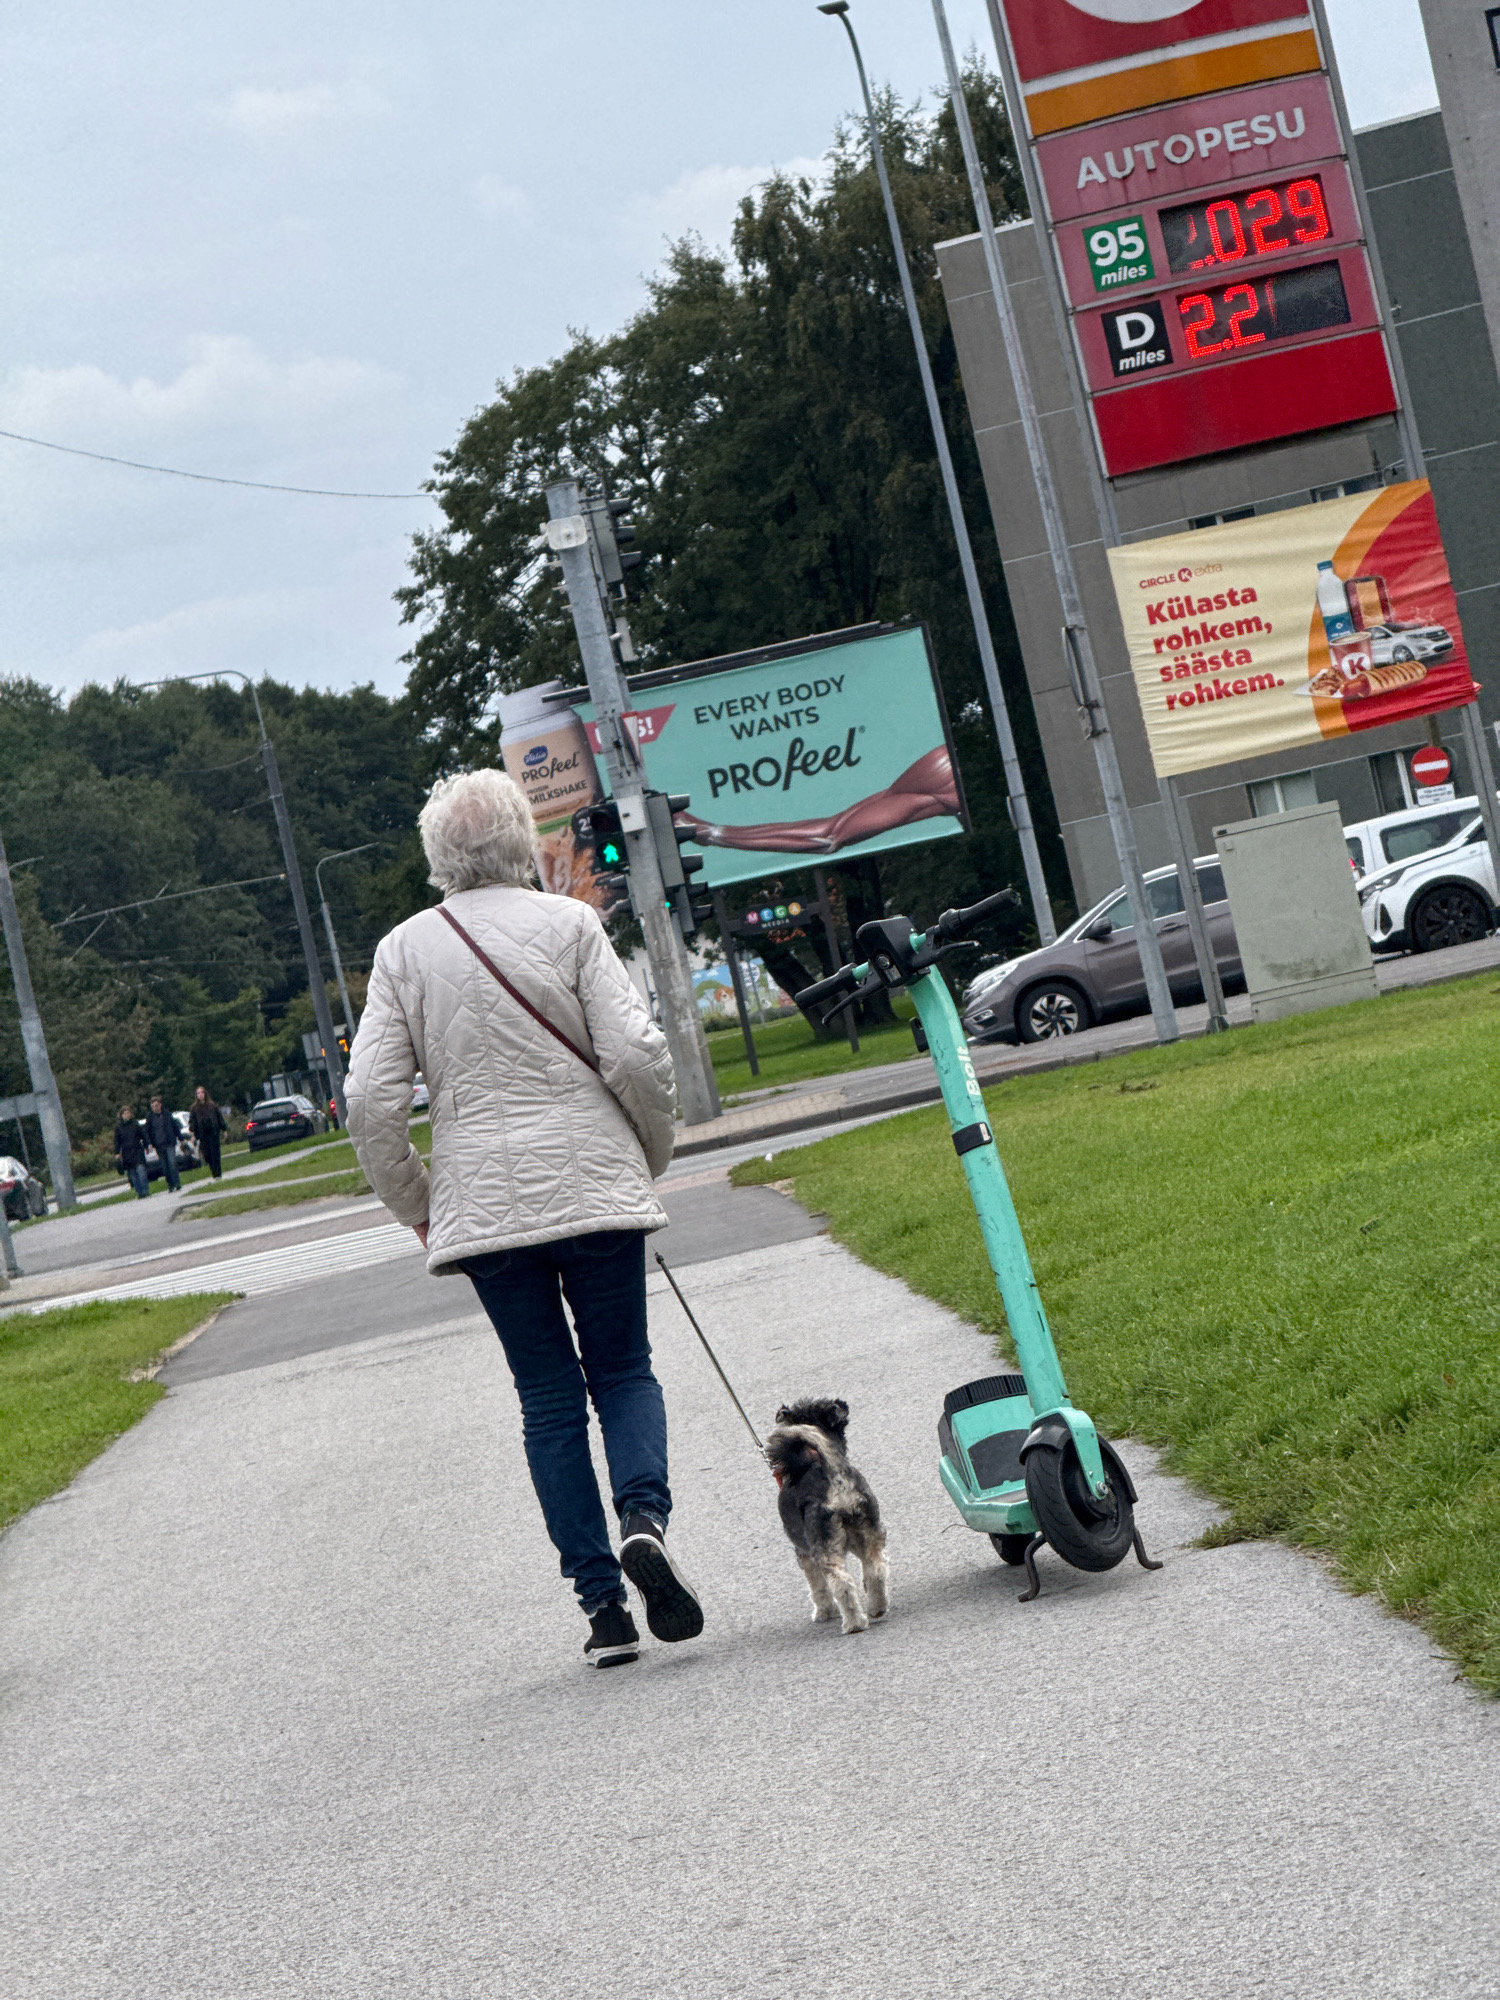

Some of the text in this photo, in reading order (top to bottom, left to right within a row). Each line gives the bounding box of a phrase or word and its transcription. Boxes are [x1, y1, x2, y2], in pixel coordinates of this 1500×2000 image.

[1076, 107, 1306, 190] AUTOPESU
[1089, 223, 1146, 267] 95
[1100, 263, 1147, 287] miles
[1116, 311, 1155, 350] D
[1118, 347, 1166, 372] miles
[1139, 563, 1223, 589] CIRCLE K extra
[1145, 587, 1258, 626] Külasta
[1153, 616, 1273, 654] rohkem,
[1159, 648, 1253, 683] säästa
[1348, 656, 1366, 676] K
[694, 674, 845, 725] EVERY BODY
[1166, 672, 1285, 711] rohkem.
[729, 706, 821, 741] WANTS
[525, 751, 547, 763] Valio
[529, 779, 588, 805] MILKSHAKE
[578, 817, 592, 831] 2
[747, 903, 800, 924] MEGA
[957, 1046, 981, 1096] Bolt
